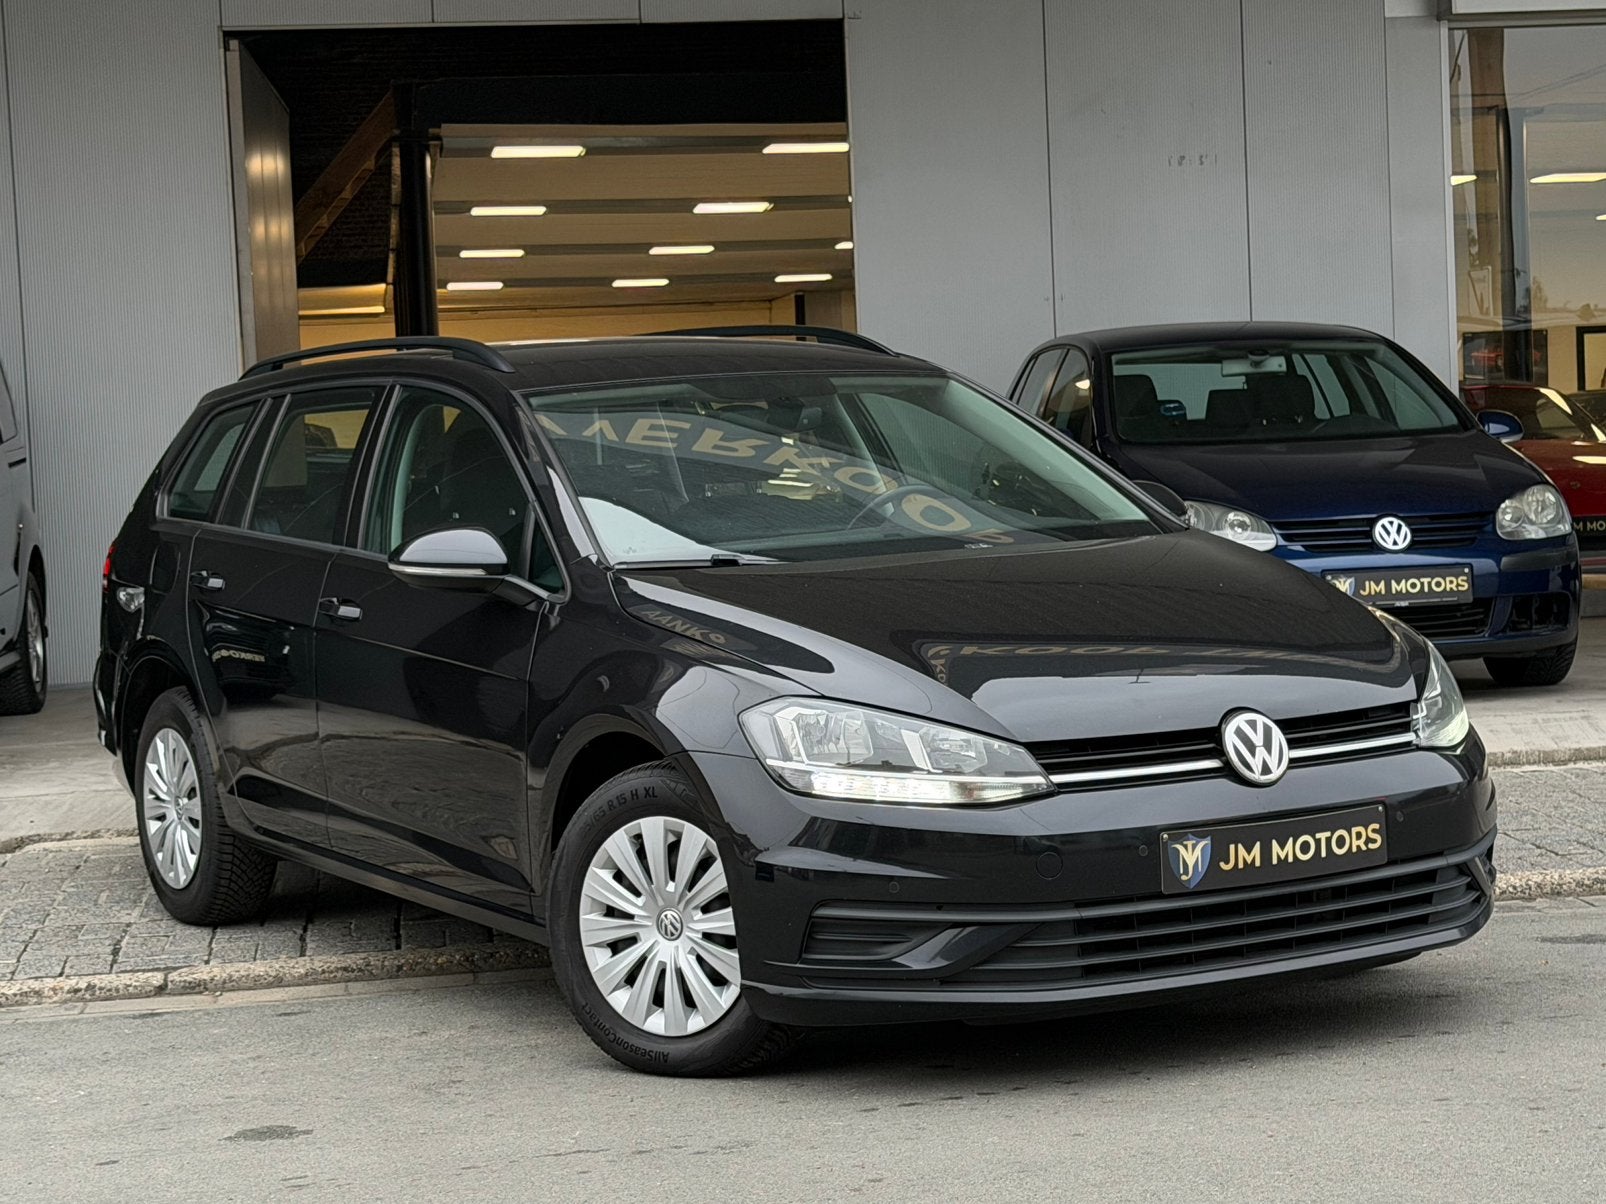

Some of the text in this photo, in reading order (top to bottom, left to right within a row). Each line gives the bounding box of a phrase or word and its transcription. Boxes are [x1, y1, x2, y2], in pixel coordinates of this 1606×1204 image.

[1586, 520, 1606, 531] MO
[1360, 580, 1386, 596] JM
[1391, 576, 1469, 595] MOTORS
[1225, 712, 1288, 783] VW
[630, 788, 639, 800] H
[643, 785, 659, 799] XL
[1218, 823, 1382, 871] JM MOTORS
[582, 1002, 670, 1063] AllSeasonContact
